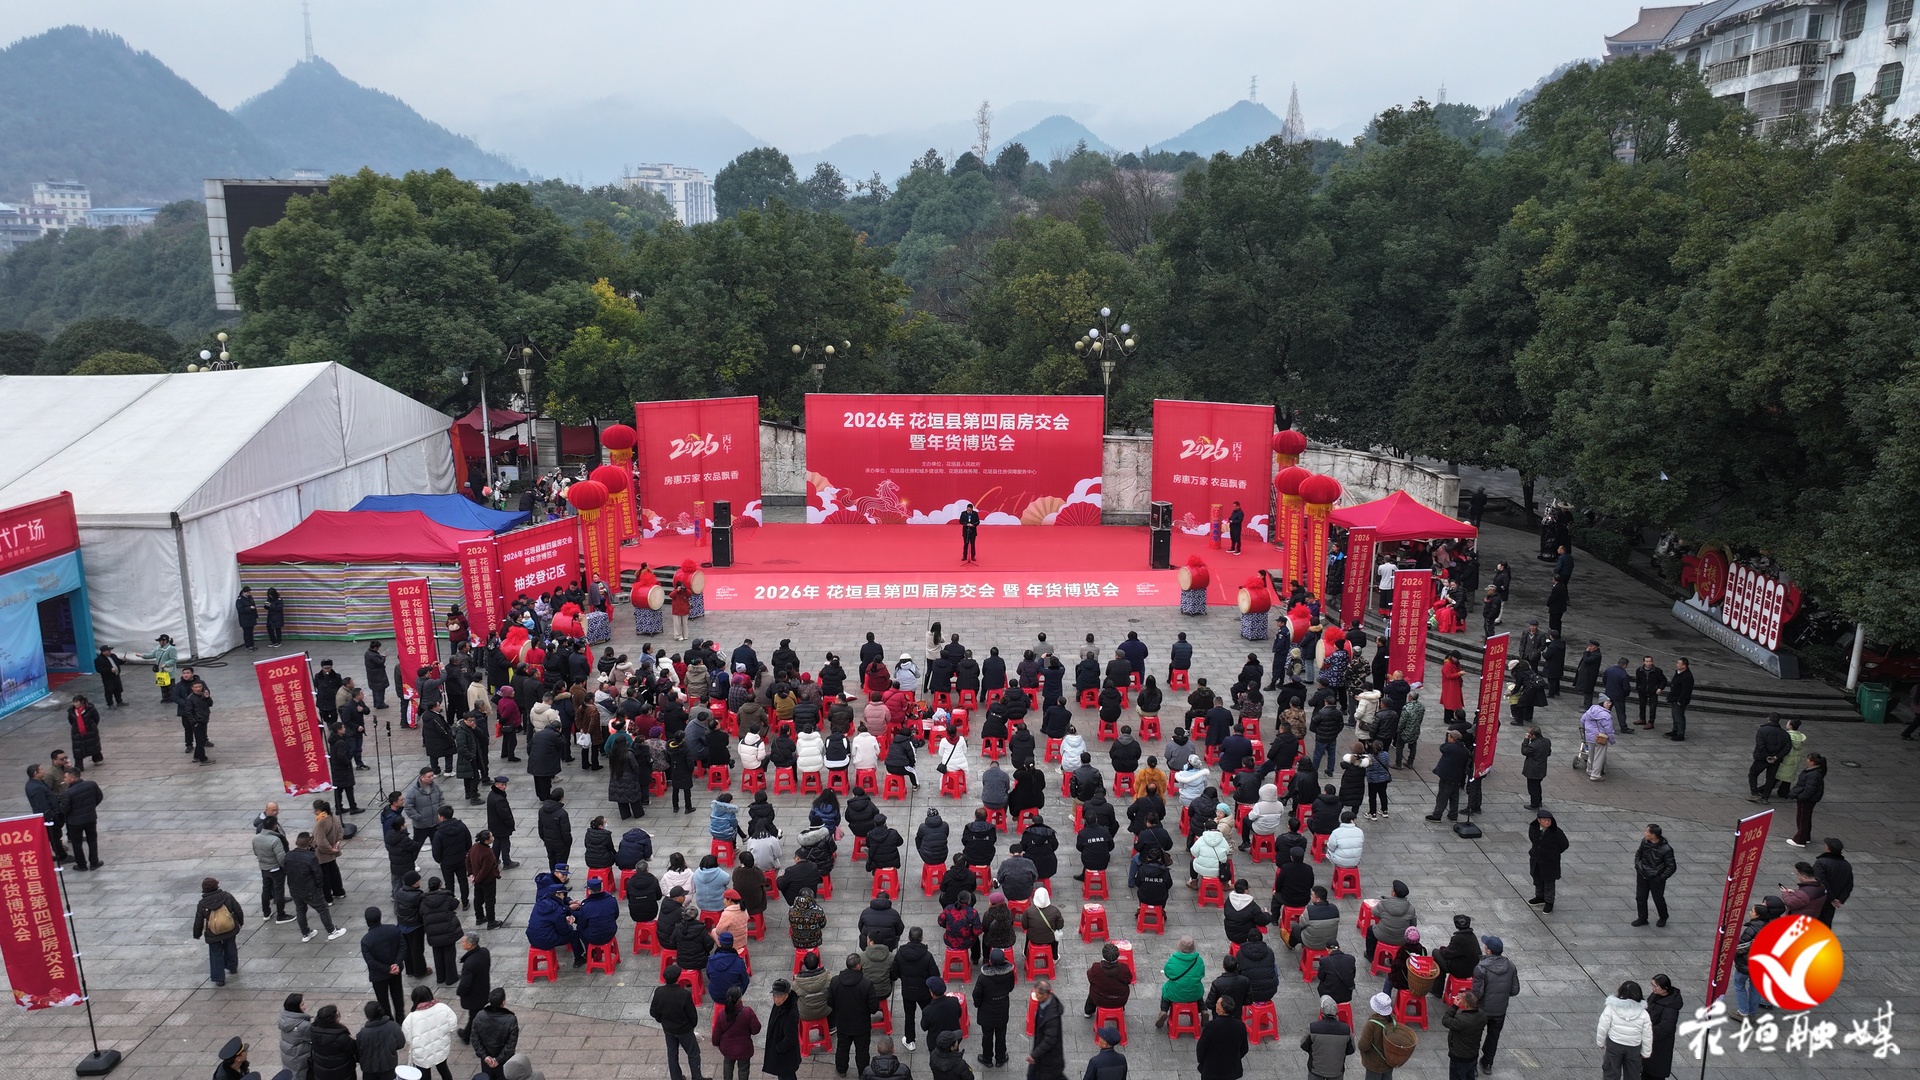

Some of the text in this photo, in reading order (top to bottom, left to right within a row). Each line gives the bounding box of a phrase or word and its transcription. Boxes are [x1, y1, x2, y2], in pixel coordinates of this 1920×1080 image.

[843, 411, 1070, 431] 2026年 花垣县第四届房交会
[669, 432, 720, 460] 2026
[722, 433, 732, 454] 丙午
[908, 434, 1015, 452] 暨年货博览会
[1180, 436, 1230, 463] 2026
[1232, 441, 1243, 462] 丙午
[663, 470, 740, 486] 房惠万家 农品飘香
[1172, 474, 1248, 490] 房惠万家 农品飘香
[466, 546, 487, 555] 2026
[503, 536, 573, 562] 2026年 花垣县第四届房交会
[524, 549, 557, 565] 暨年货博览会
[468, 558, 482, 608] 暨年货博览会
[514, 563, 566, 592] 抽奖登记区
[1347, 545, 1360, 593] 暨年货博览会
[1353, 545, 1368, 617] 花垣县第四届房交会
[1401, 577, 1423, 586] 2026
[397, 586, 420, 596] 2026
[479, 557, 497, 631] 花垣县第四届房交会
[754, 584, 820, 600] 2026年
[826, 583, 996, 599] 花垣县第四届房交会
[1002, 583, 1020, 598] 暨
[1026, 582, 1120, 598] 年货博览会
[399, 600, 417, 655] 暨年货博览会
[1397, 590, 1410, 645] 暨年货博览会
[1406, 590, 1421, 672] 花垣县第四届房交会
[412, 598, 430, 668] 花垣县第四届房
[1490, 644, 1504, 655] 2026
[268, 664, 298, 680] 2026
[1478, 661, 1494, 726] 暨年货博览会
[272, 682, 297, 748] 暨年货博览会
[1483, 659, 1502, 757] 花垣县第四届房交会
[288, 679, 319, 773] 花垣县第四届房交会
[1742, 826, 1763, 844] 2026
[0, 853, 32, 943] 暨年货博览会
[19, 850, 65, 980] 花垣县第四届房交会
[1716, 846, 1758, 982] 花垣县第四届房交会
